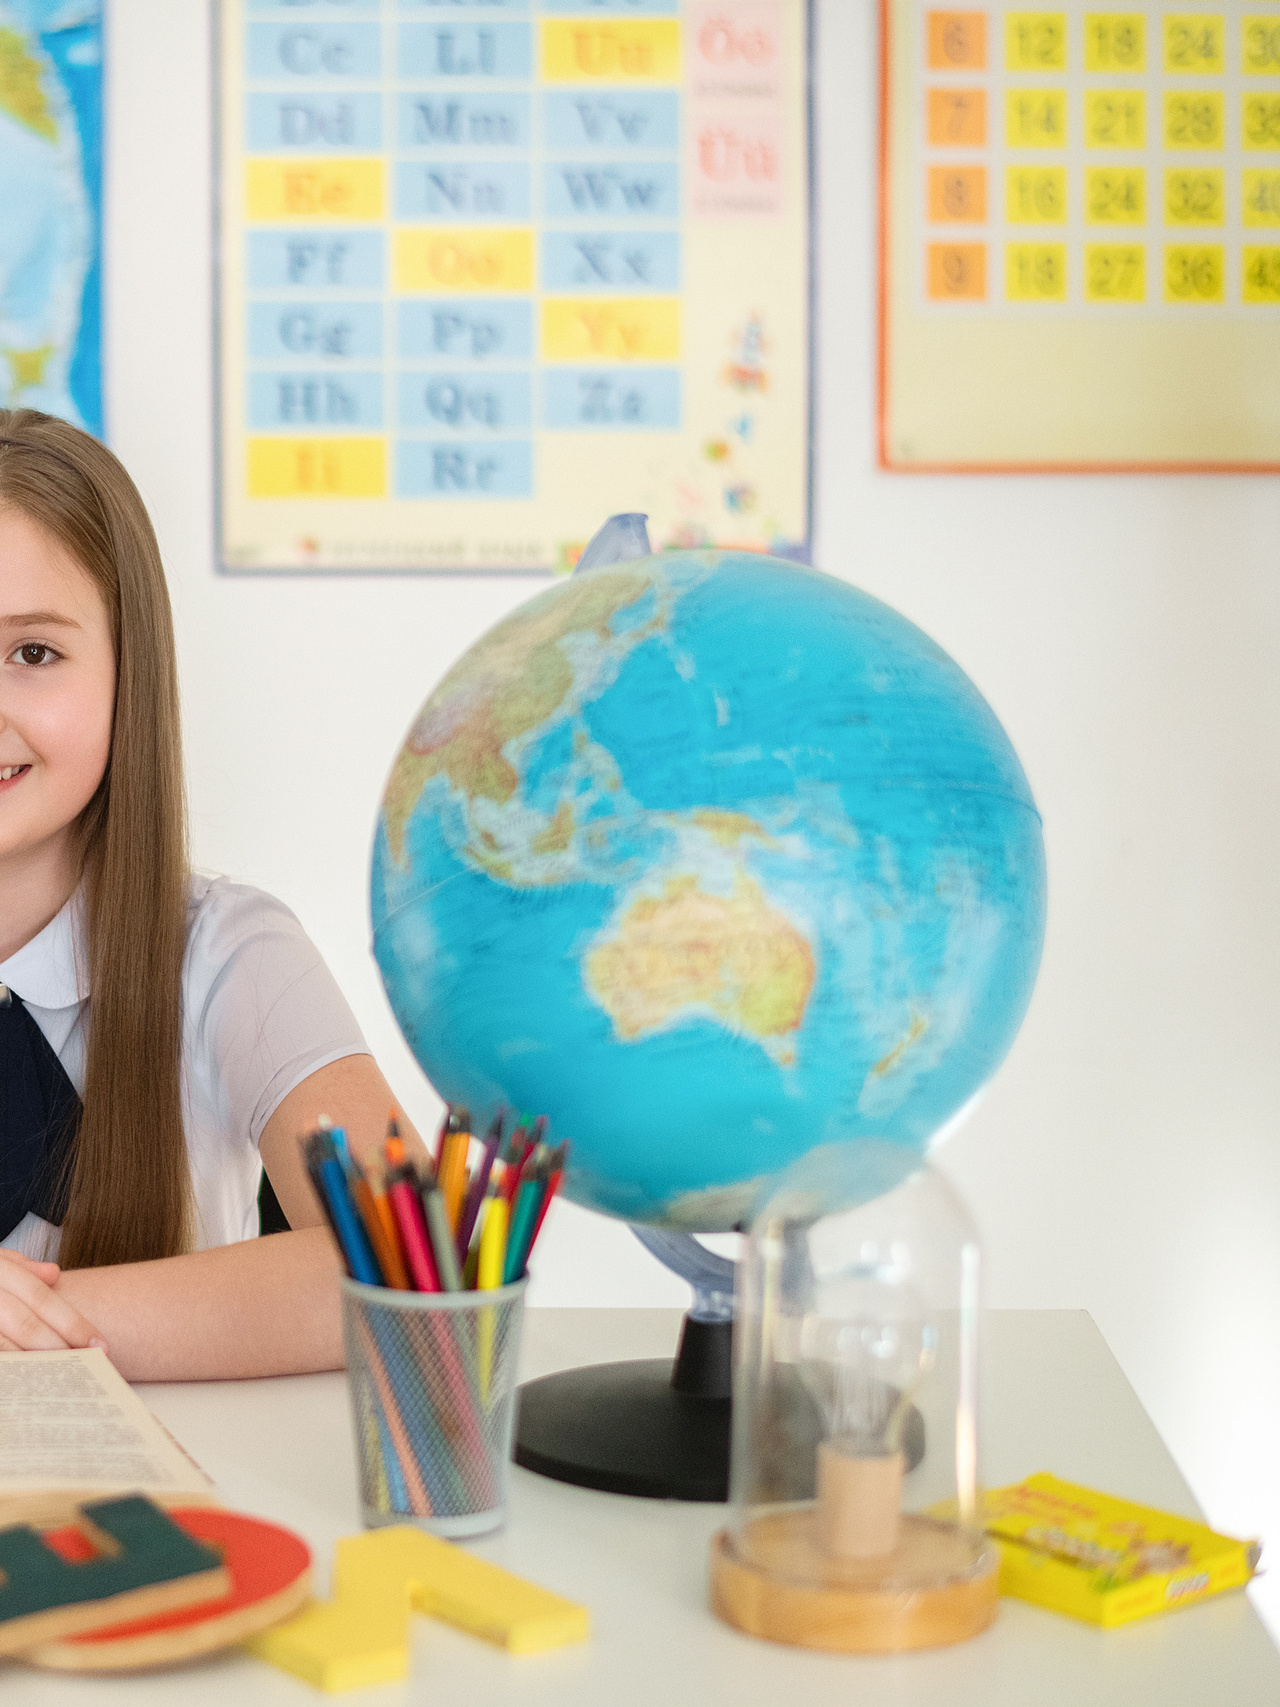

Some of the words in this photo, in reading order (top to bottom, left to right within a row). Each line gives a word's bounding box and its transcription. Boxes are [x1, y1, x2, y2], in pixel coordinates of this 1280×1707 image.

[943, 19, 971, 63] 6
[1017, 19, 1060, 65] 12
[1097, 20, 1140, 66] 18
[1168, 21, 1216, 66] 24
[278, 101, 358, 146] Dd
[414, 101, 516, 146] Mm
[945, 94, 971, 139] 7
[1017, 95, 1058, 139] 14
[1092, 97, 1138, 142] 21
[1168, 98, 1218, 143] 28
[943, 174, 971, 218] 8
[1090, 178, 1138, 219] 24
[1170, 179, 1220, 220] 32
[427, 241, 504, 286] Oo
[943, 250, 971, 295] 9
[1017, 252, 1061, 297] 18
[1090, 253, 1139, 297] 27
[1168, 253, 1218, 298] 36
[432, 311, 505, 358] Pp
[278, 380, 358, 424] Hh
